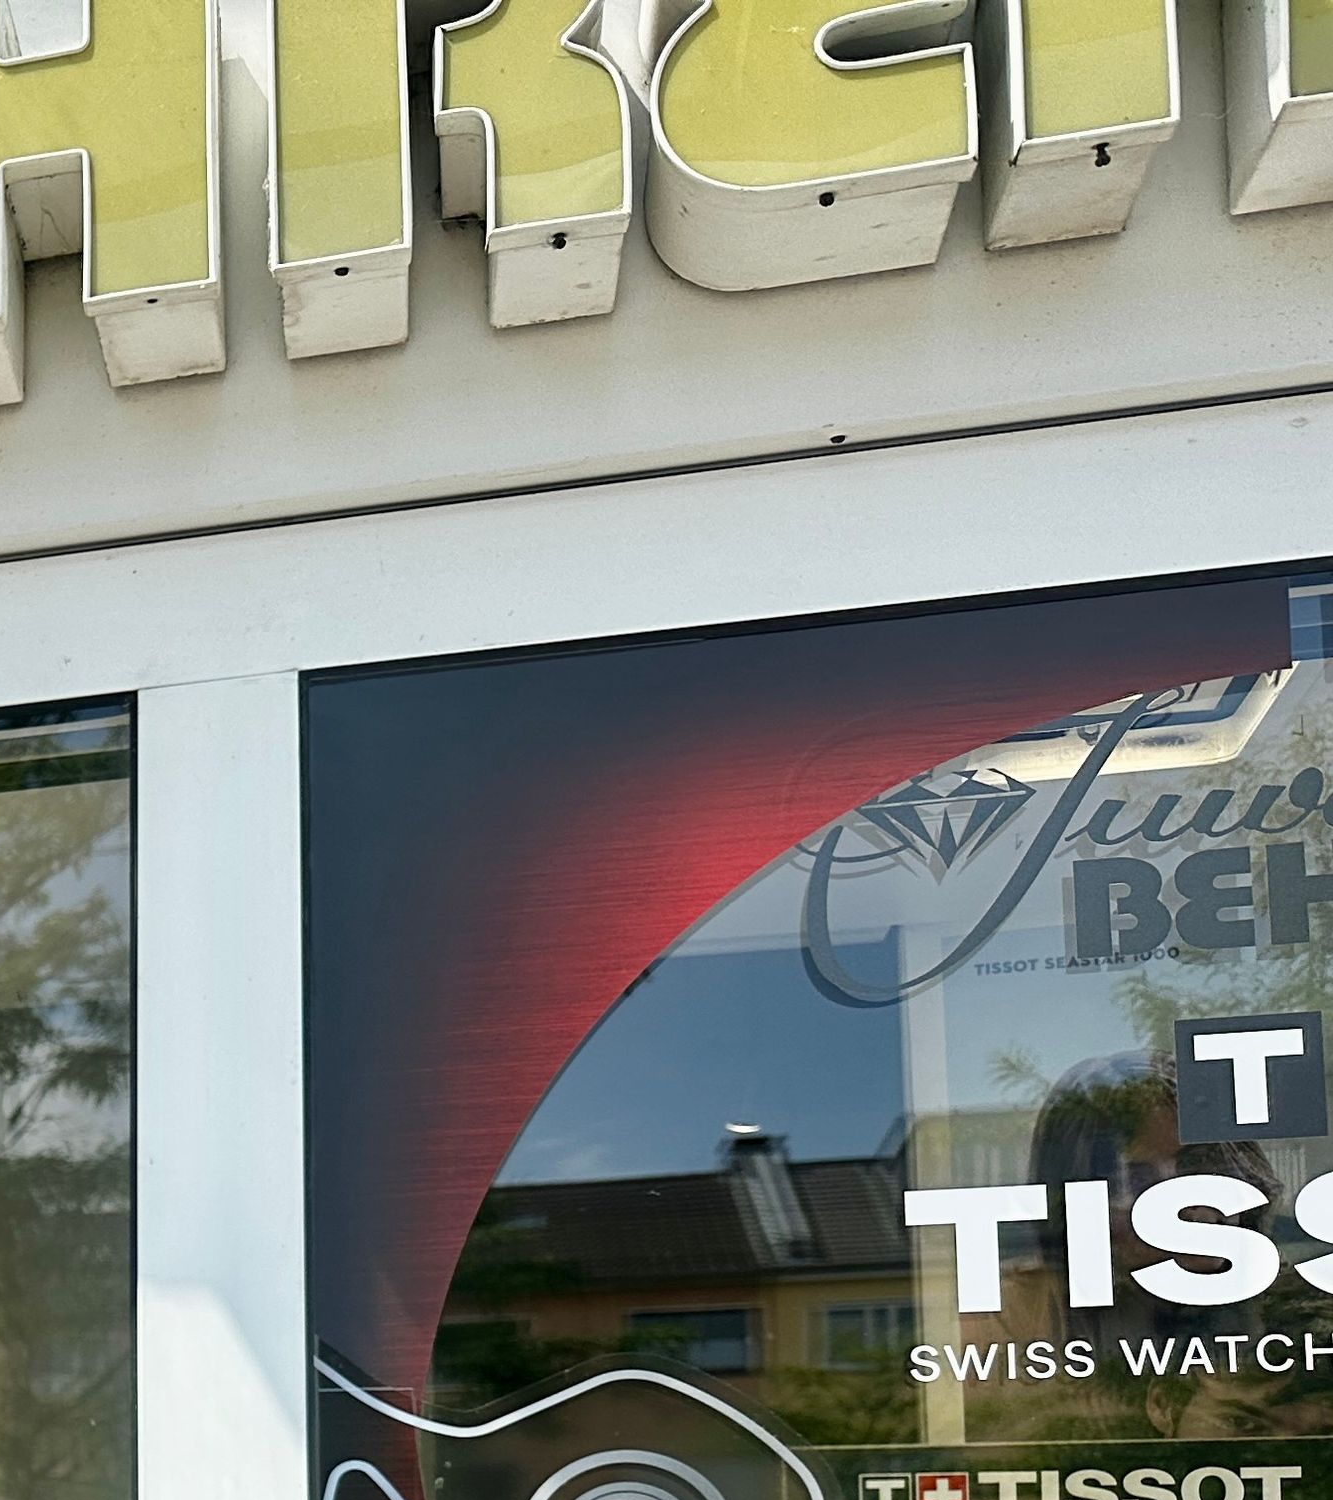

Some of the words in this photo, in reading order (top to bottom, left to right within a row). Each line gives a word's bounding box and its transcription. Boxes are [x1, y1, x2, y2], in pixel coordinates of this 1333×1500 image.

[974, 958, 1039, 976] TISSOT
[1192, 1028, 1305, 1126] T
[904, 1174, 1333, 1314] TIS
[909, 1338, 1096, 1383] SWISS
